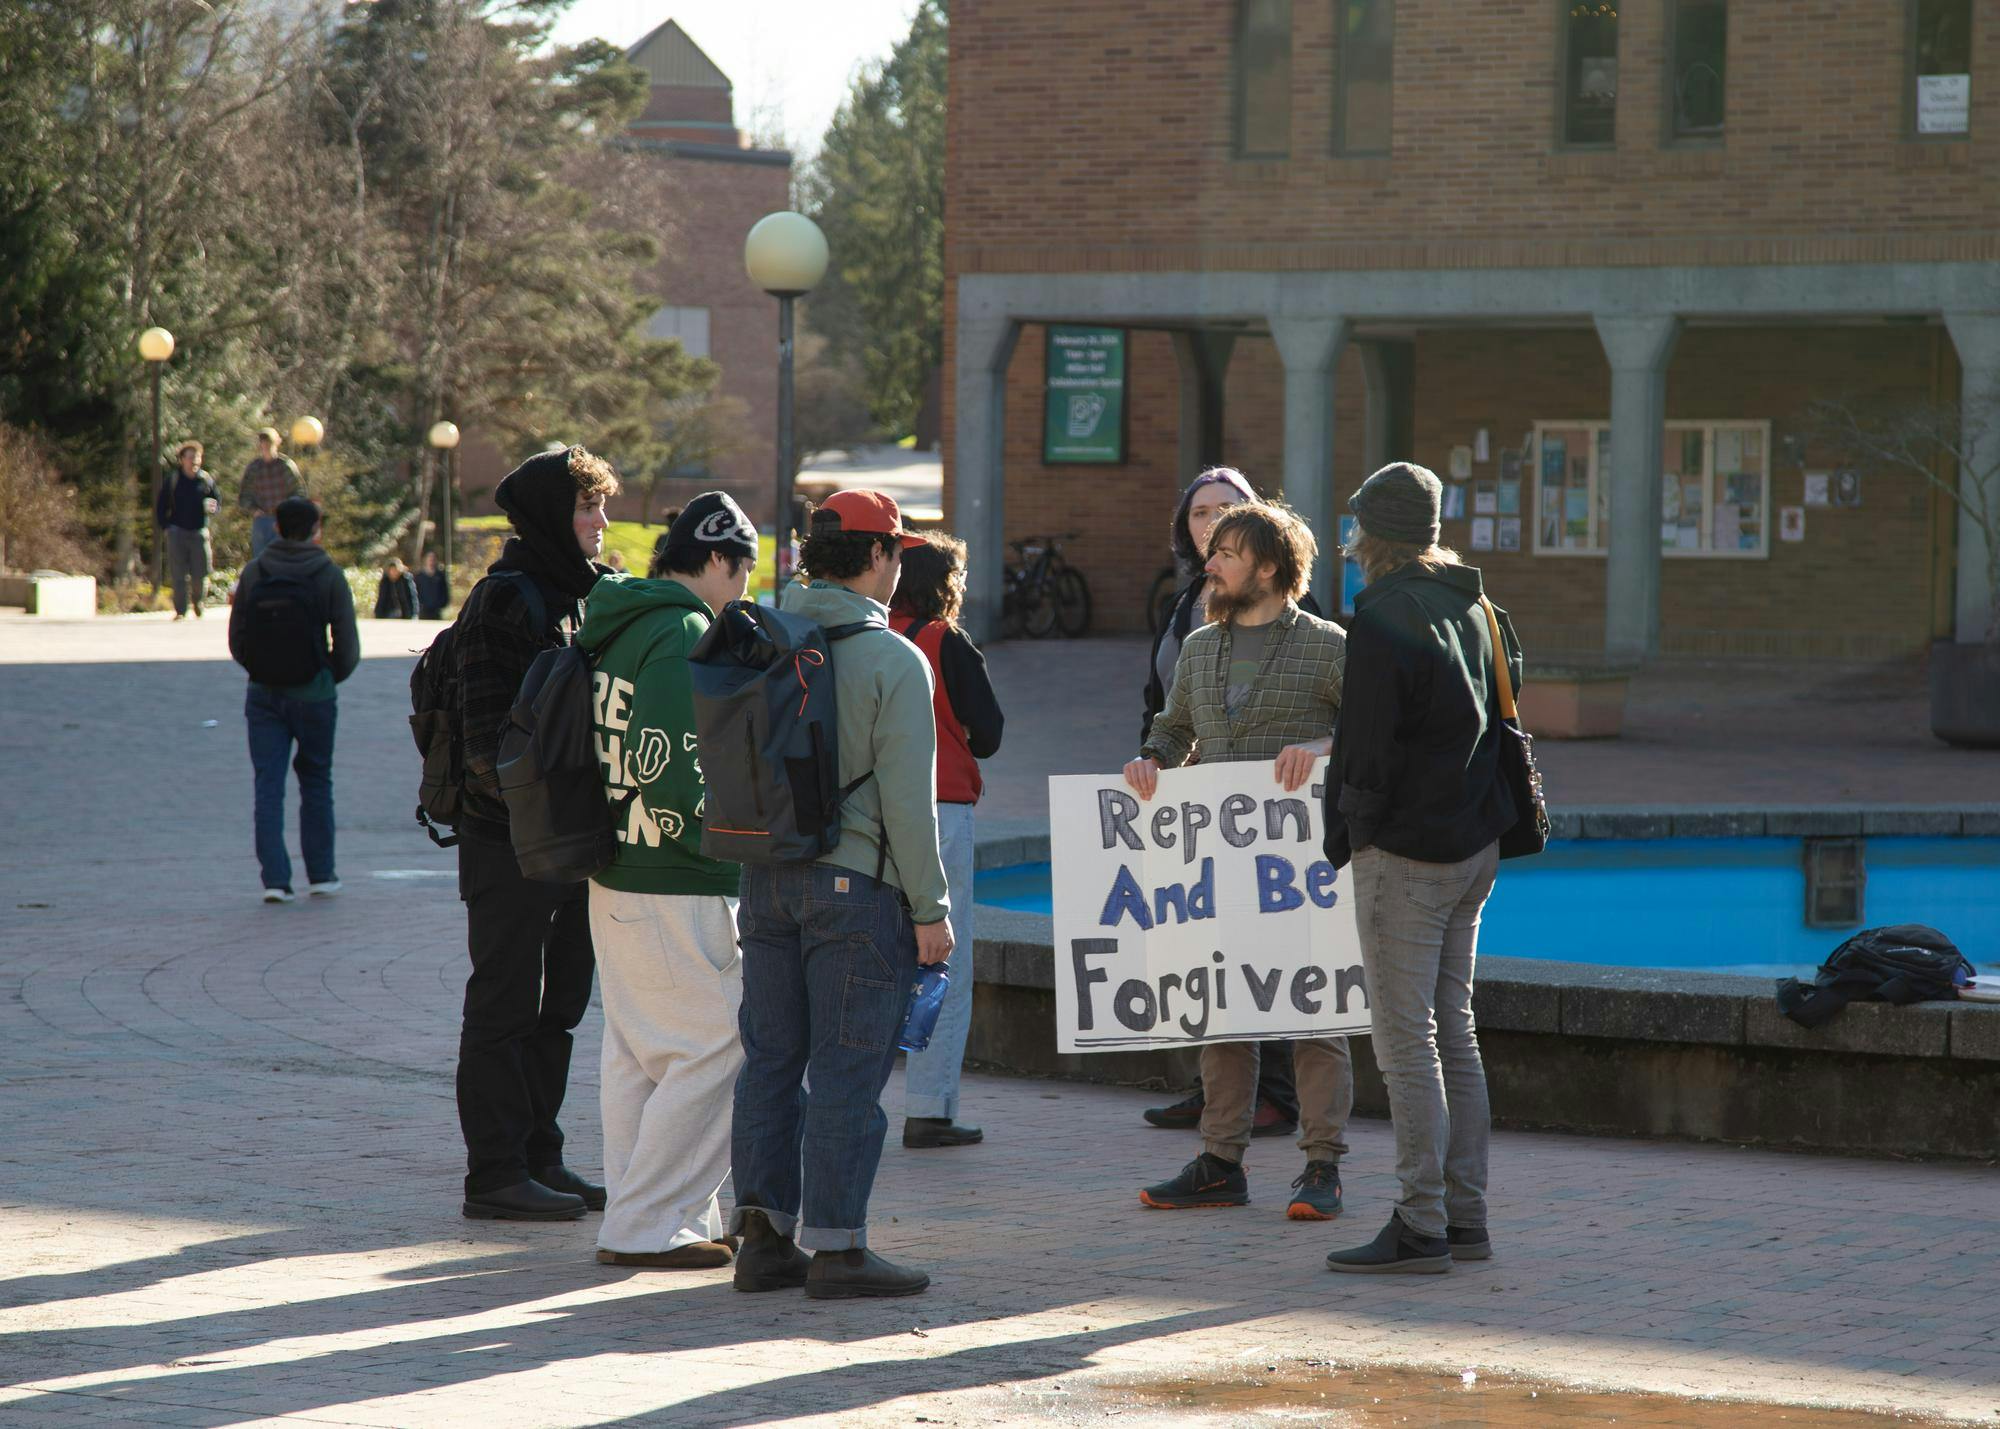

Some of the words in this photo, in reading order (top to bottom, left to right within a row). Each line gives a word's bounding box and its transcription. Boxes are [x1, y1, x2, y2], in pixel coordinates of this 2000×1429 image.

[1099, 856, 1216, 930] And
[1255, 854, 1338, 913] Be
[1071, 938, 1370, 1038] Forgiven
